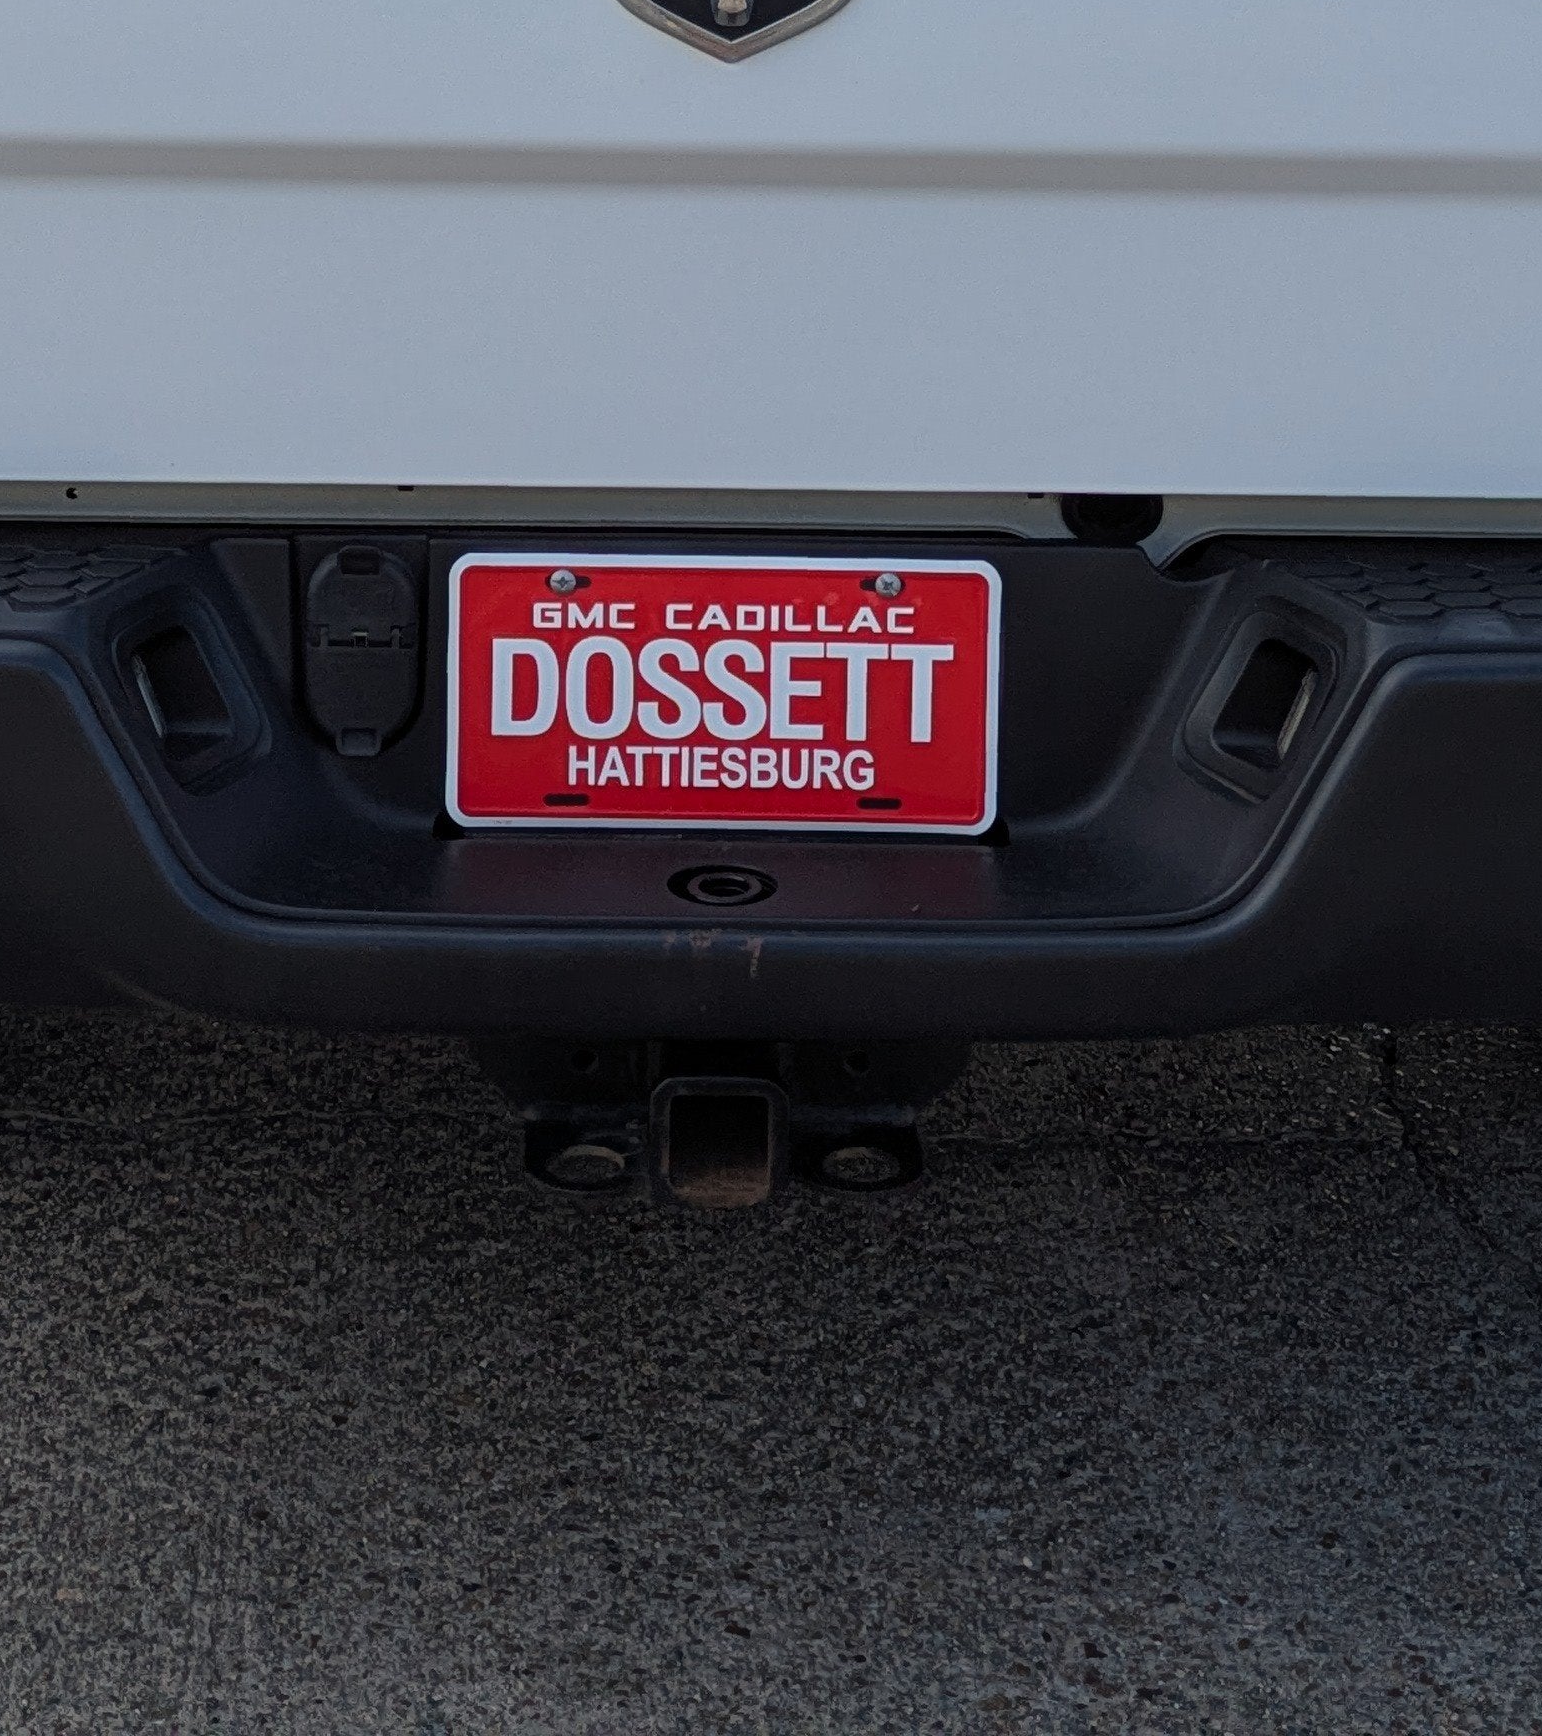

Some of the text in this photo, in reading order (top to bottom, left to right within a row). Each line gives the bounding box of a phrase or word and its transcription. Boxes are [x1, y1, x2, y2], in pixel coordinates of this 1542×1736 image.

[532, 601, 916, 635] GMC CADILLAC
[490, 635, 955, 744] DOSSETT
[567, 745, 876, 791] HATTIESBURG
